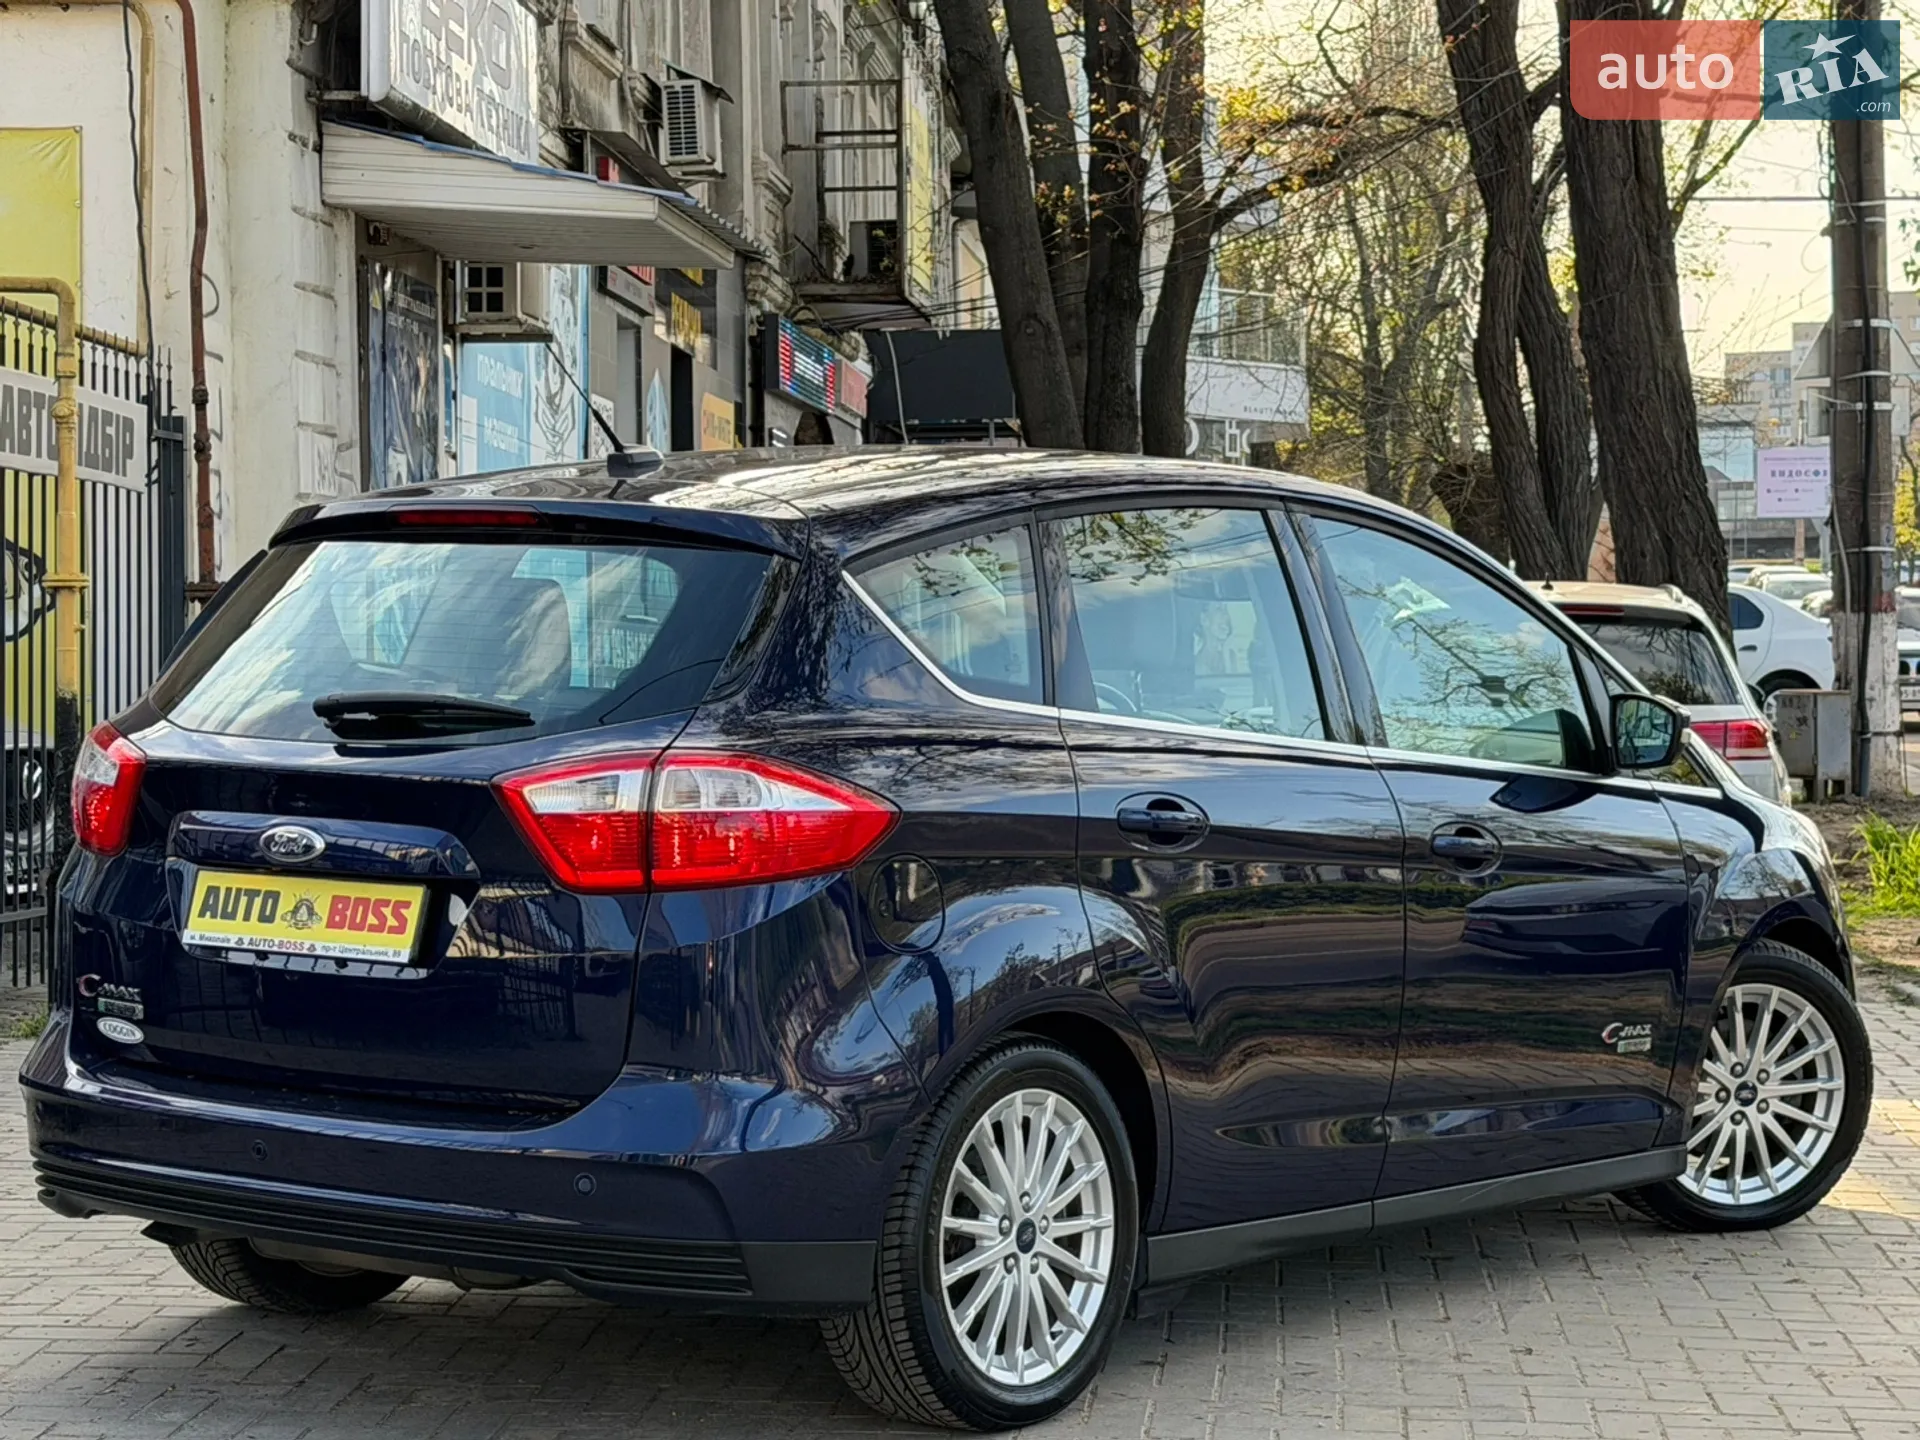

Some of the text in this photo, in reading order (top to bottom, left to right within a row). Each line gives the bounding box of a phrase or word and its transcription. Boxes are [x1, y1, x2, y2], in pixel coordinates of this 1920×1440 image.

[0, 384, 135, 478] АВТОІДБІР
[271, 832, 307, 854] Ford
[198, 885, 412, 935] AUTO BOSS
[247, 937, 304, 952] AUTO-BOSS
